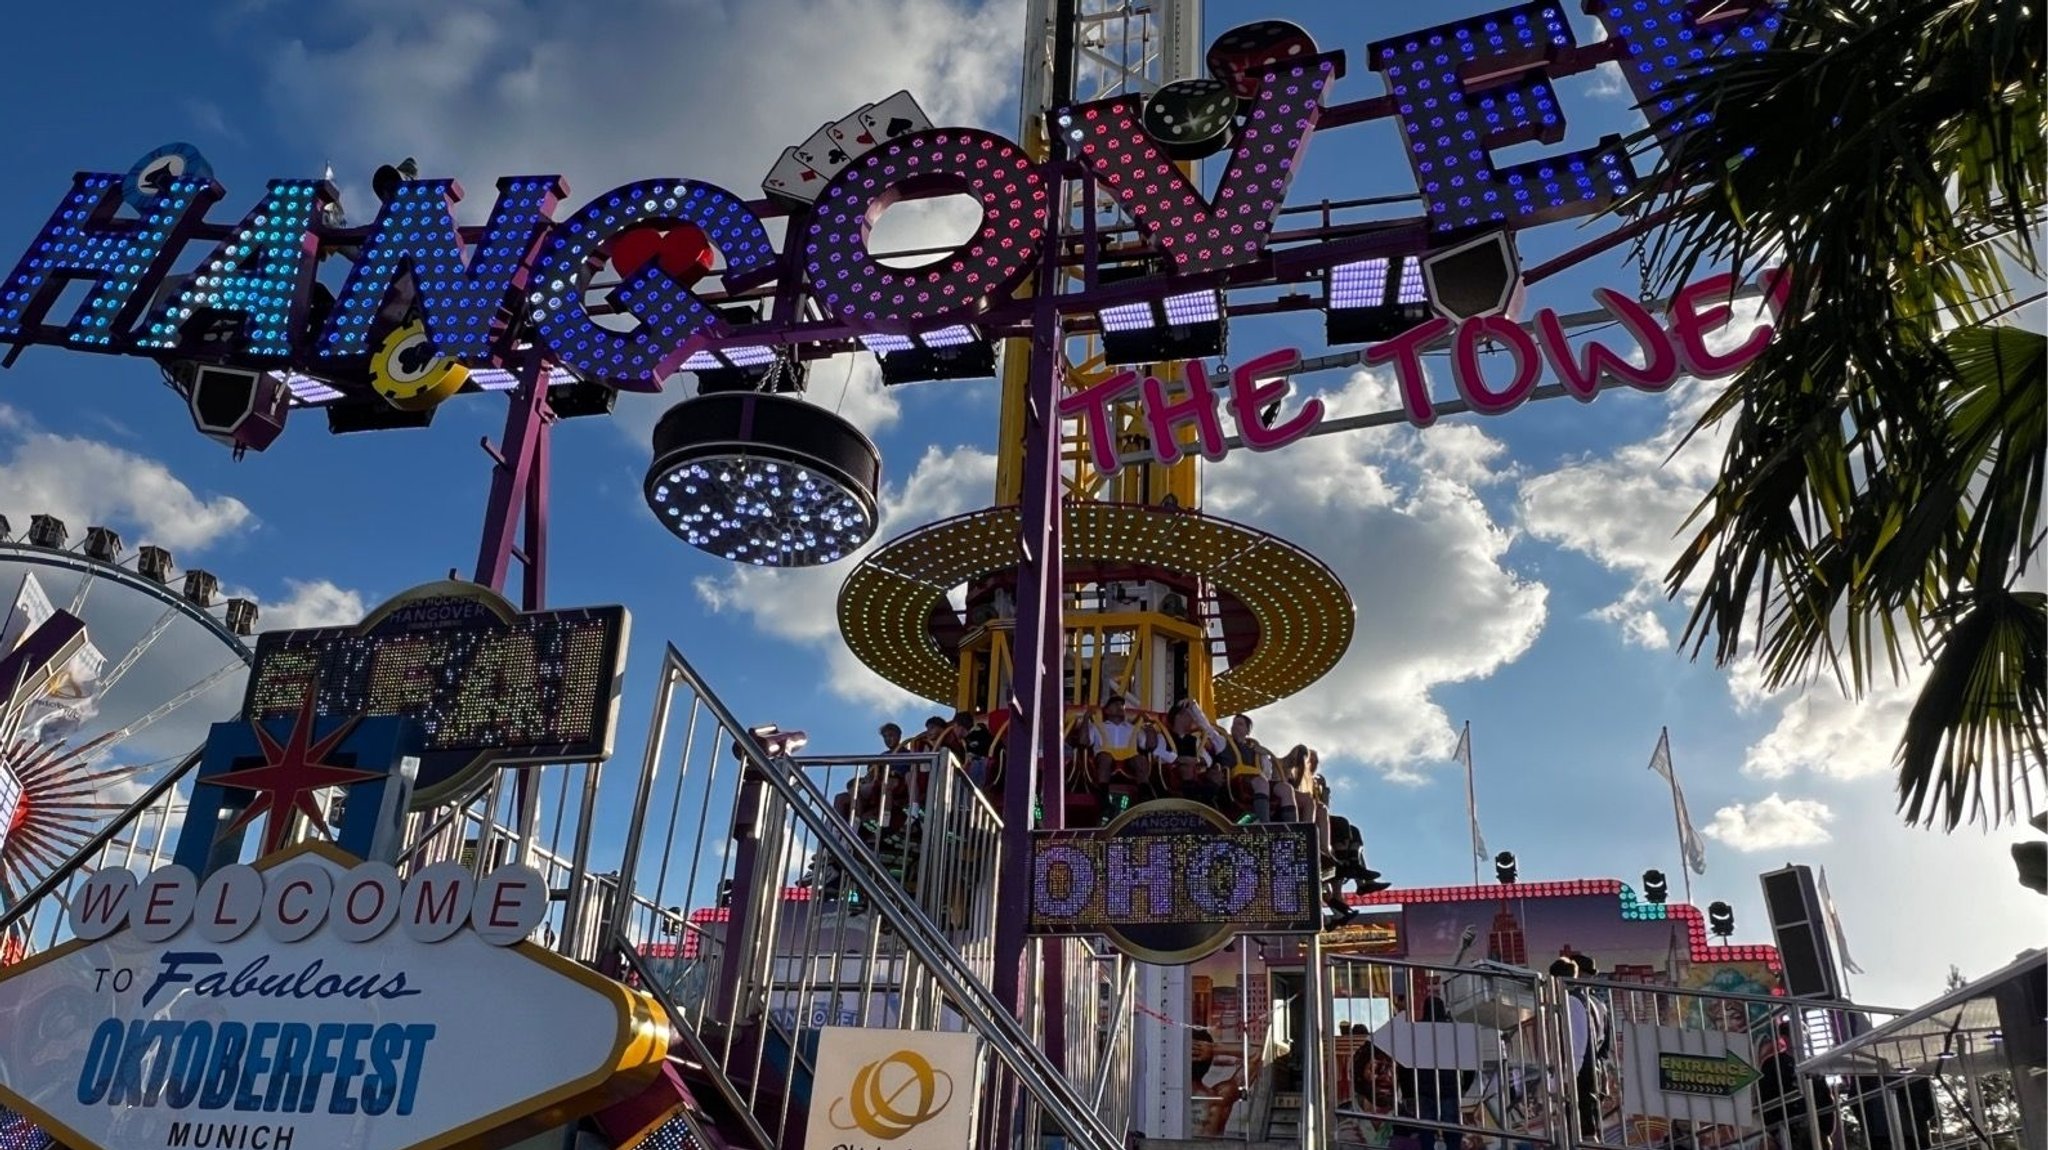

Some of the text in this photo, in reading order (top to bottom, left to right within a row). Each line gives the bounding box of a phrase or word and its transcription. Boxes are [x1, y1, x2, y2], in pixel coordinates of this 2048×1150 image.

[1057, 349, 1325, 477] THE
[390, 603, 486, 623] HANGOVER
[80, 880, 528, 928] WELCOME
[95, 951, 421, 1008] TO Fabulous
[77, 1017, 437, 1117] OKTOBERFEST
[1660, 1057, 1749, 1077] ENTRANCE
[1672, 1071, 1737, 1087] EINGANG
[167, 1122, 295, 1150] MUNICH
